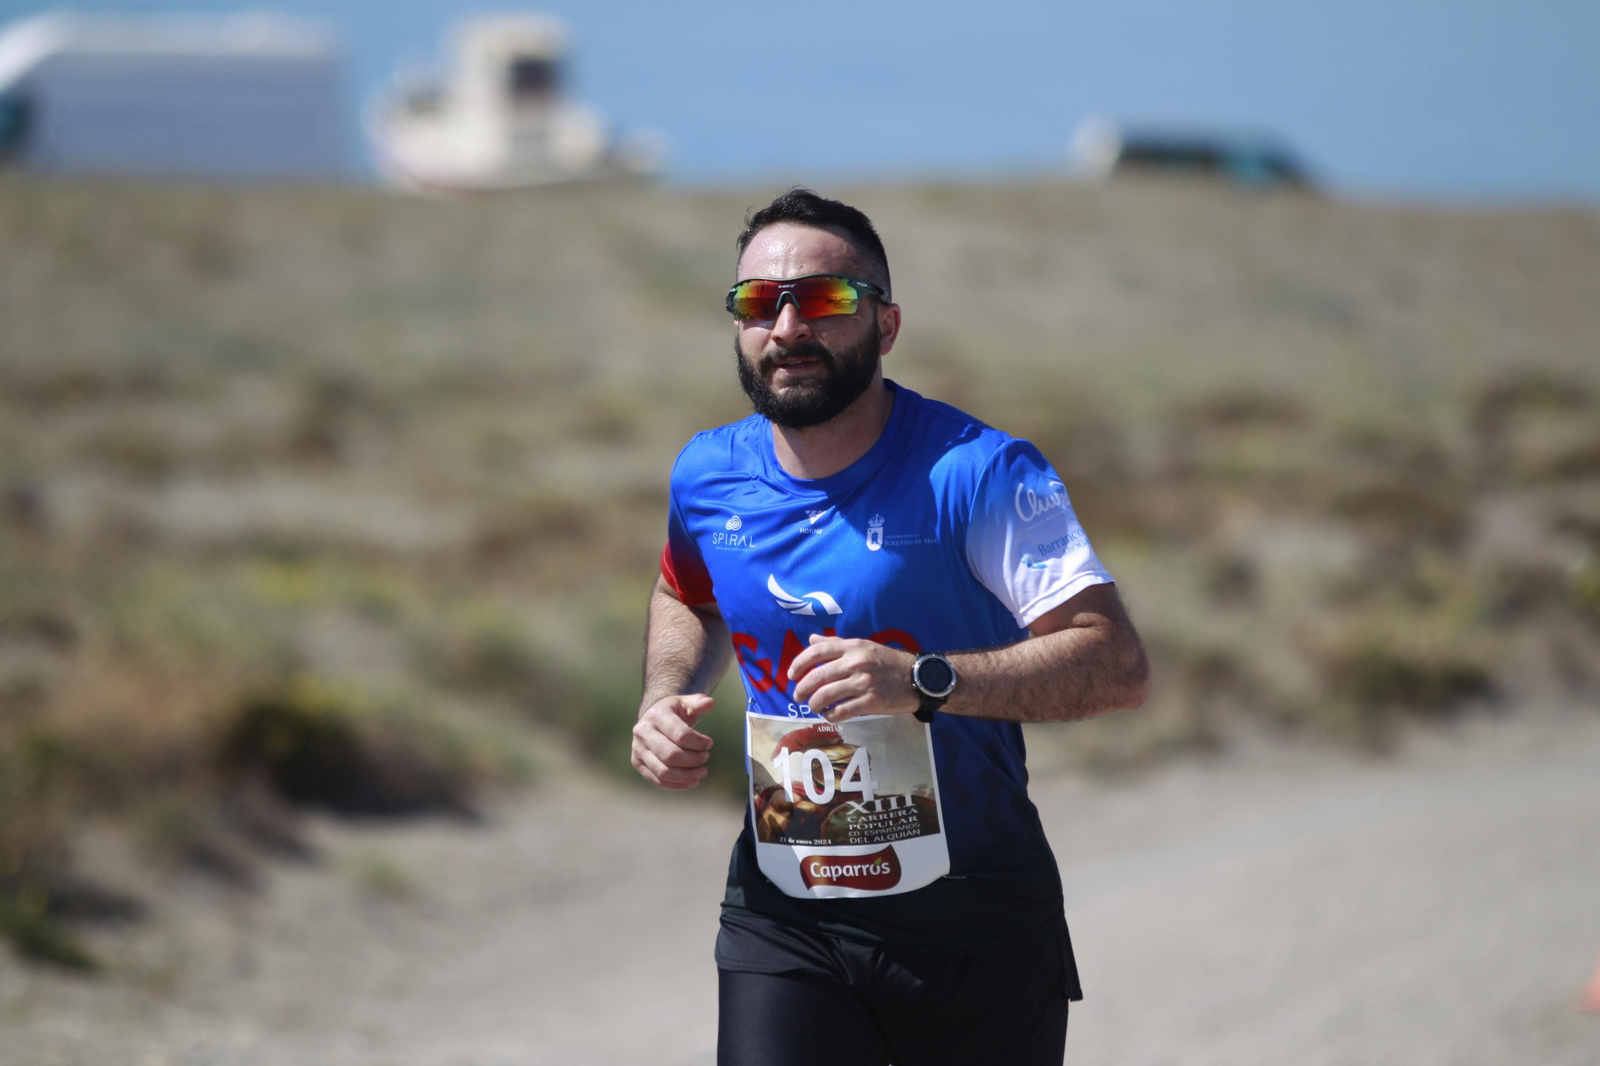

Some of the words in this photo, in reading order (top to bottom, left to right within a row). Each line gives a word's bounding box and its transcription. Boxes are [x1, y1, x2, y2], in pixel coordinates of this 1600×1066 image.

[712, 532, 756, 548] SPIRAL
[773, 746, 880, 805] 104
[846, 793, 916, 815] XIII
[847, 808, 918, 823] CARRERA
[848, 816, 918, 830] POPULAR
[864, 822, 921, 836] ESPARTANOS
